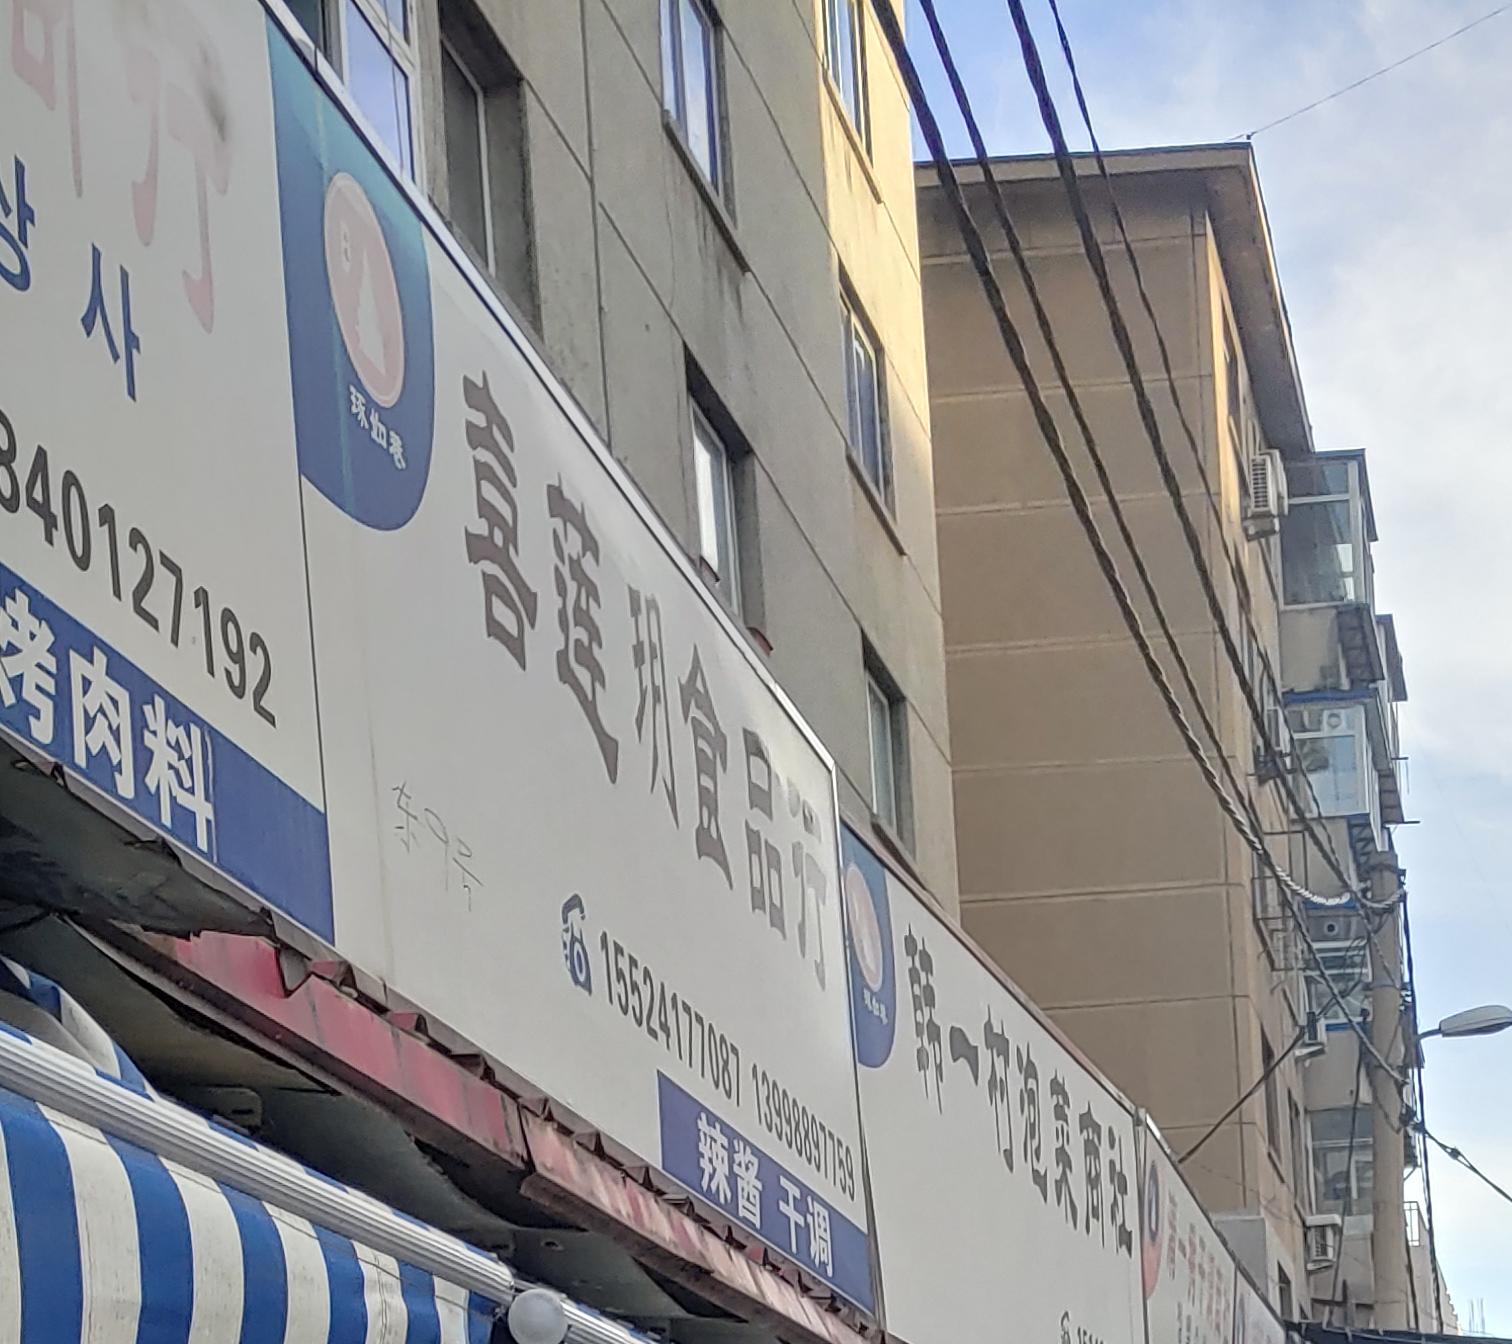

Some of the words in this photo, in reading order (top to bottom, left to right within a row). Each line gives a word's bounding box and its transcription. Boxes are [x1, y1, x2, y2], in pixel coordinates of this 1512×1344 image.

[600, 930, 741, 1107] 15524177087
[751, 1062, 856, 1202] 13998897759
[697, 1111, 763, 1230] 辣酱
[778, 1174, 834, 1278] 干调
